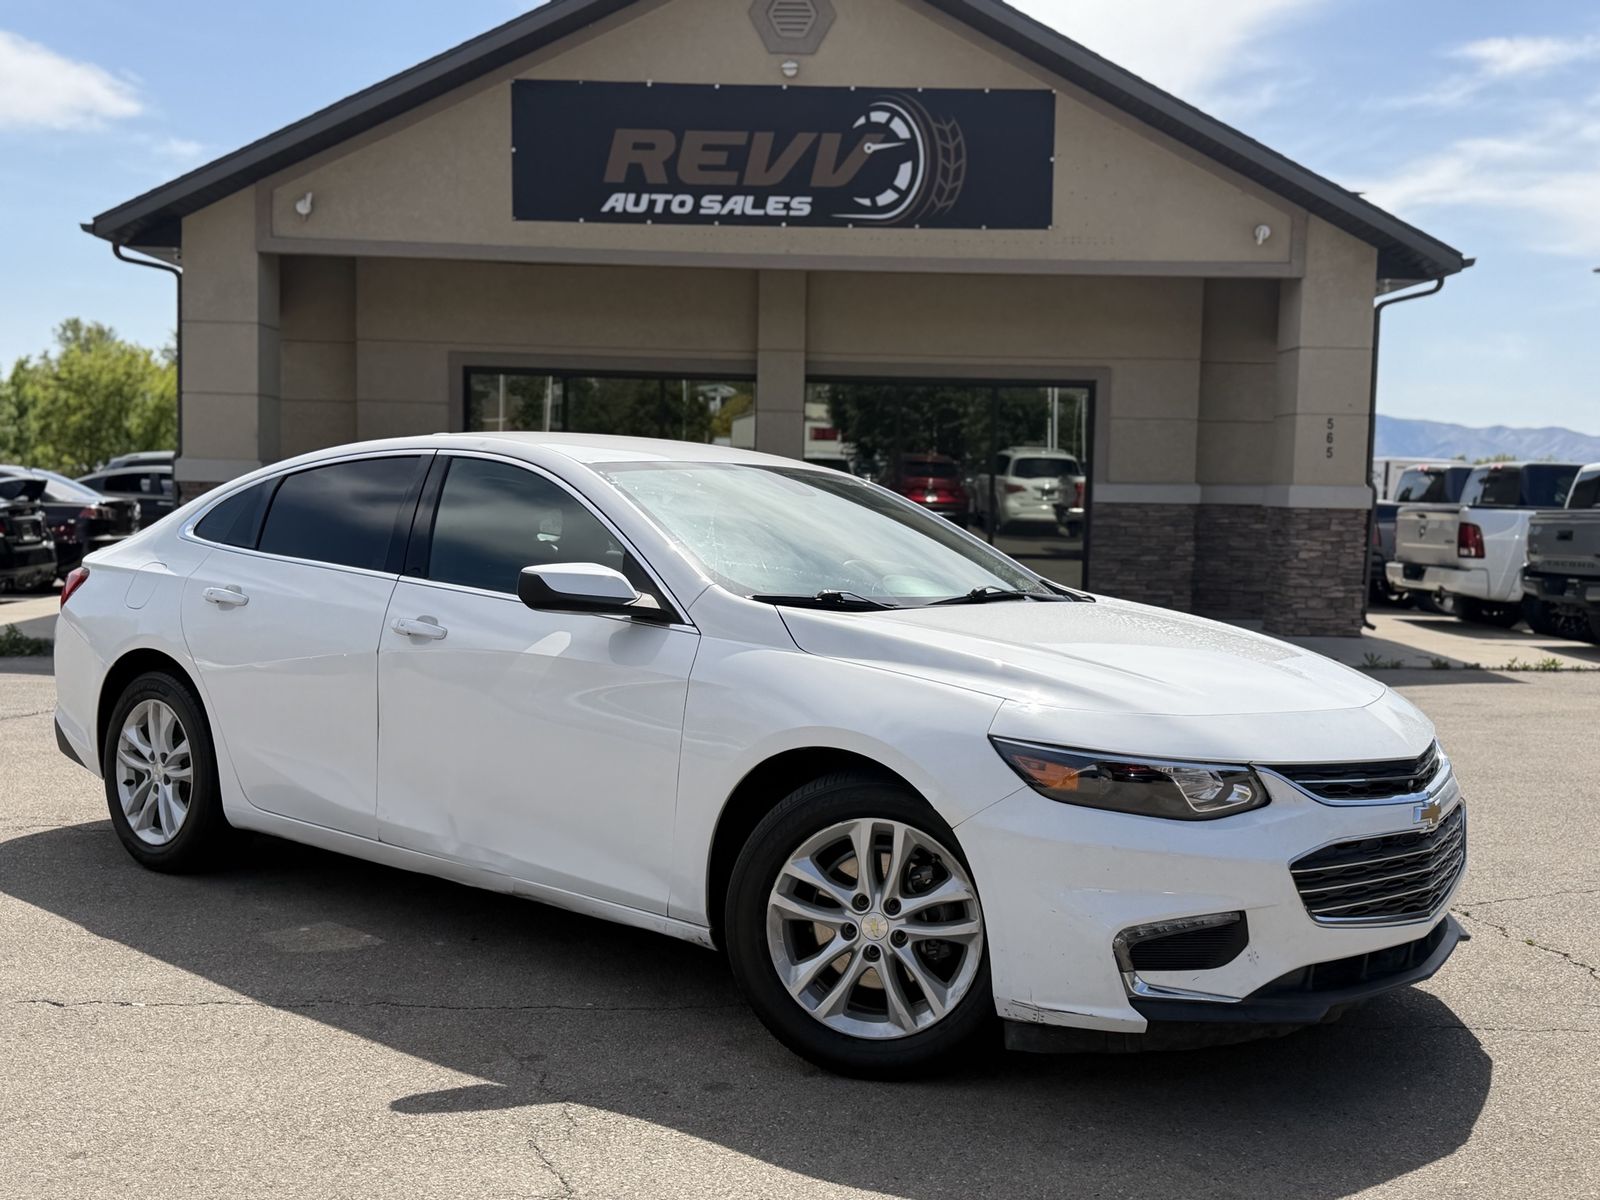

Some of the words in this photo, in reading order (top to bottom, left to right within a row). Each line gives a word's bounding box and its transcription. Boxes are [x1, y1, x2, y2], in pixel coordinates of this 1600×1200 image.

[603, 128, 886, 187] REVV
[600, 192, 694, 214] AUTO
[699, 194, 812, 216] SALES
[1326, 417, 1334, 459] 565
